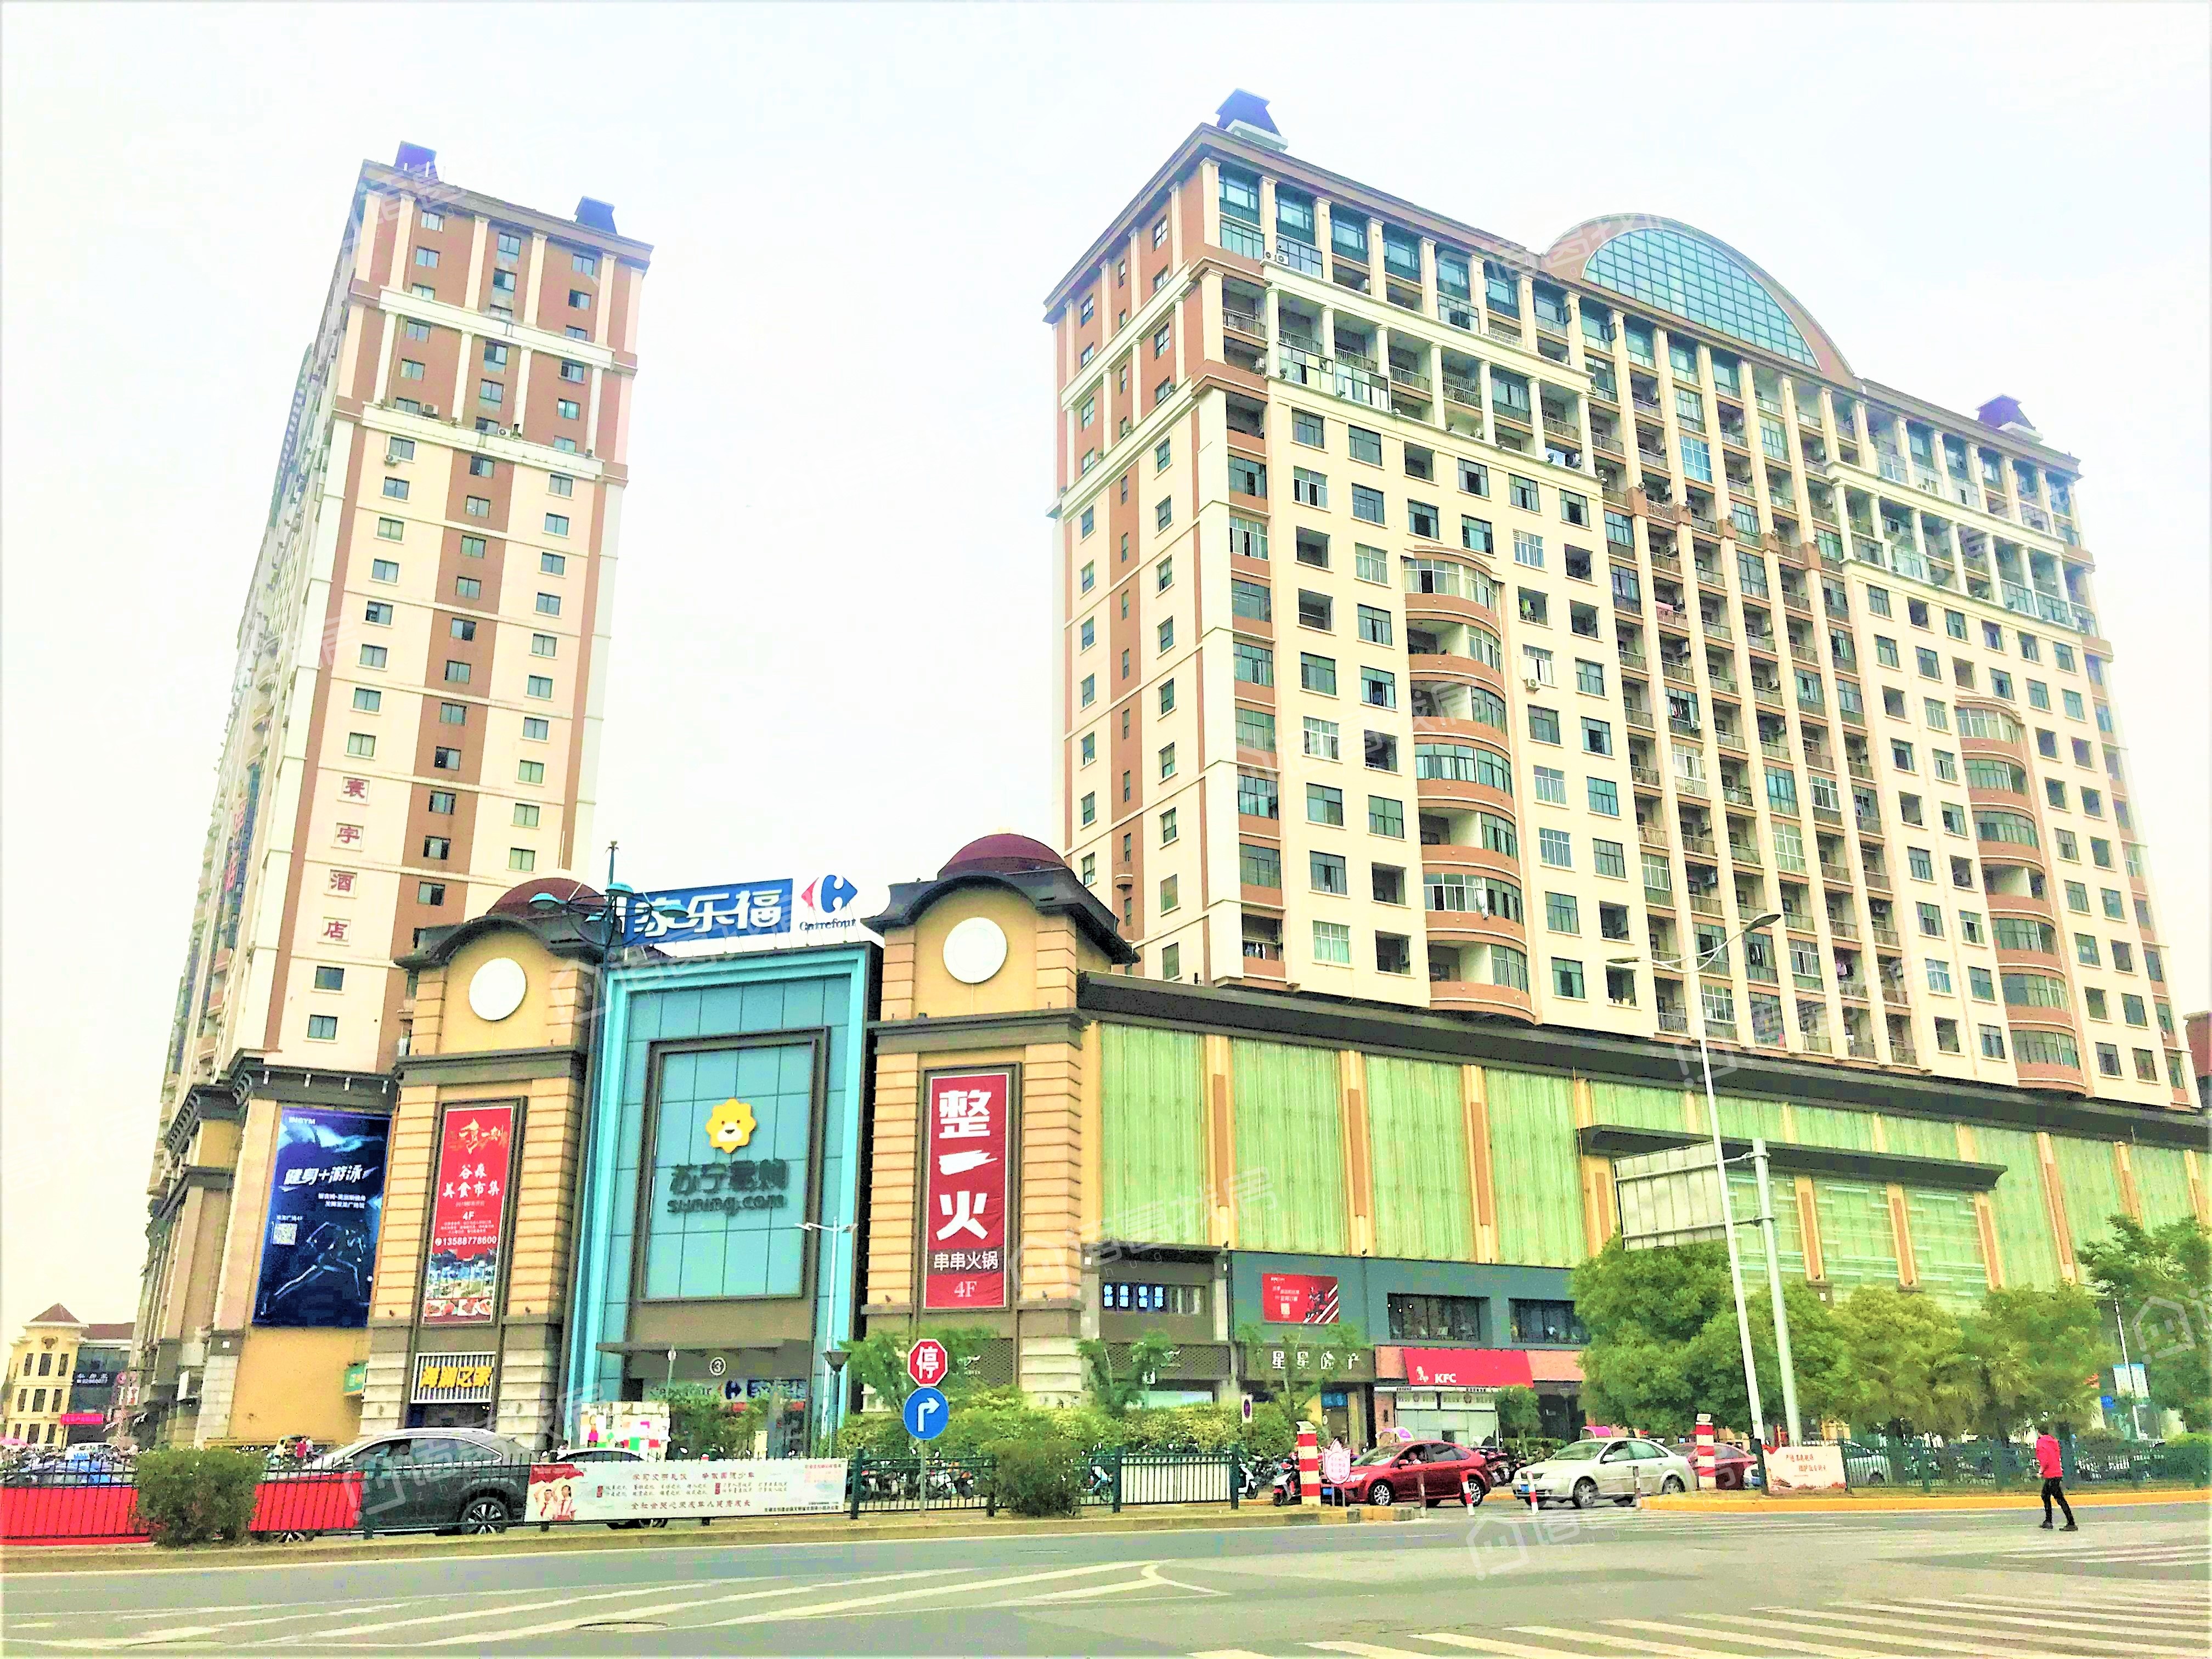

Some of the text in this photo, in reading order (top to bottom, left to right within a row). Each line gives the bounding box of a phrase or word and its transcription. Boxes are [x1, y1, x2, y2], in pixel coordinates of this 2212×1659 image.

[633, 888, 782, 936] 家乐福
[799, 917, 857, 932] Carrefour
[284, 1164, 363, 1186] 健身+游泳
[442, 1180, 500, 1199] 美食市集
[462, 1211, 475, 1221] 4F
[934, 1250, 998, 1271] 串串火锅
[953, 1280, 977, 1298] 4F
[916, 1346, 939, 1380] 停
[419, 1365, 493, 1389] 海澜之家
[1434, 1373, 1457, 1384] KFC
